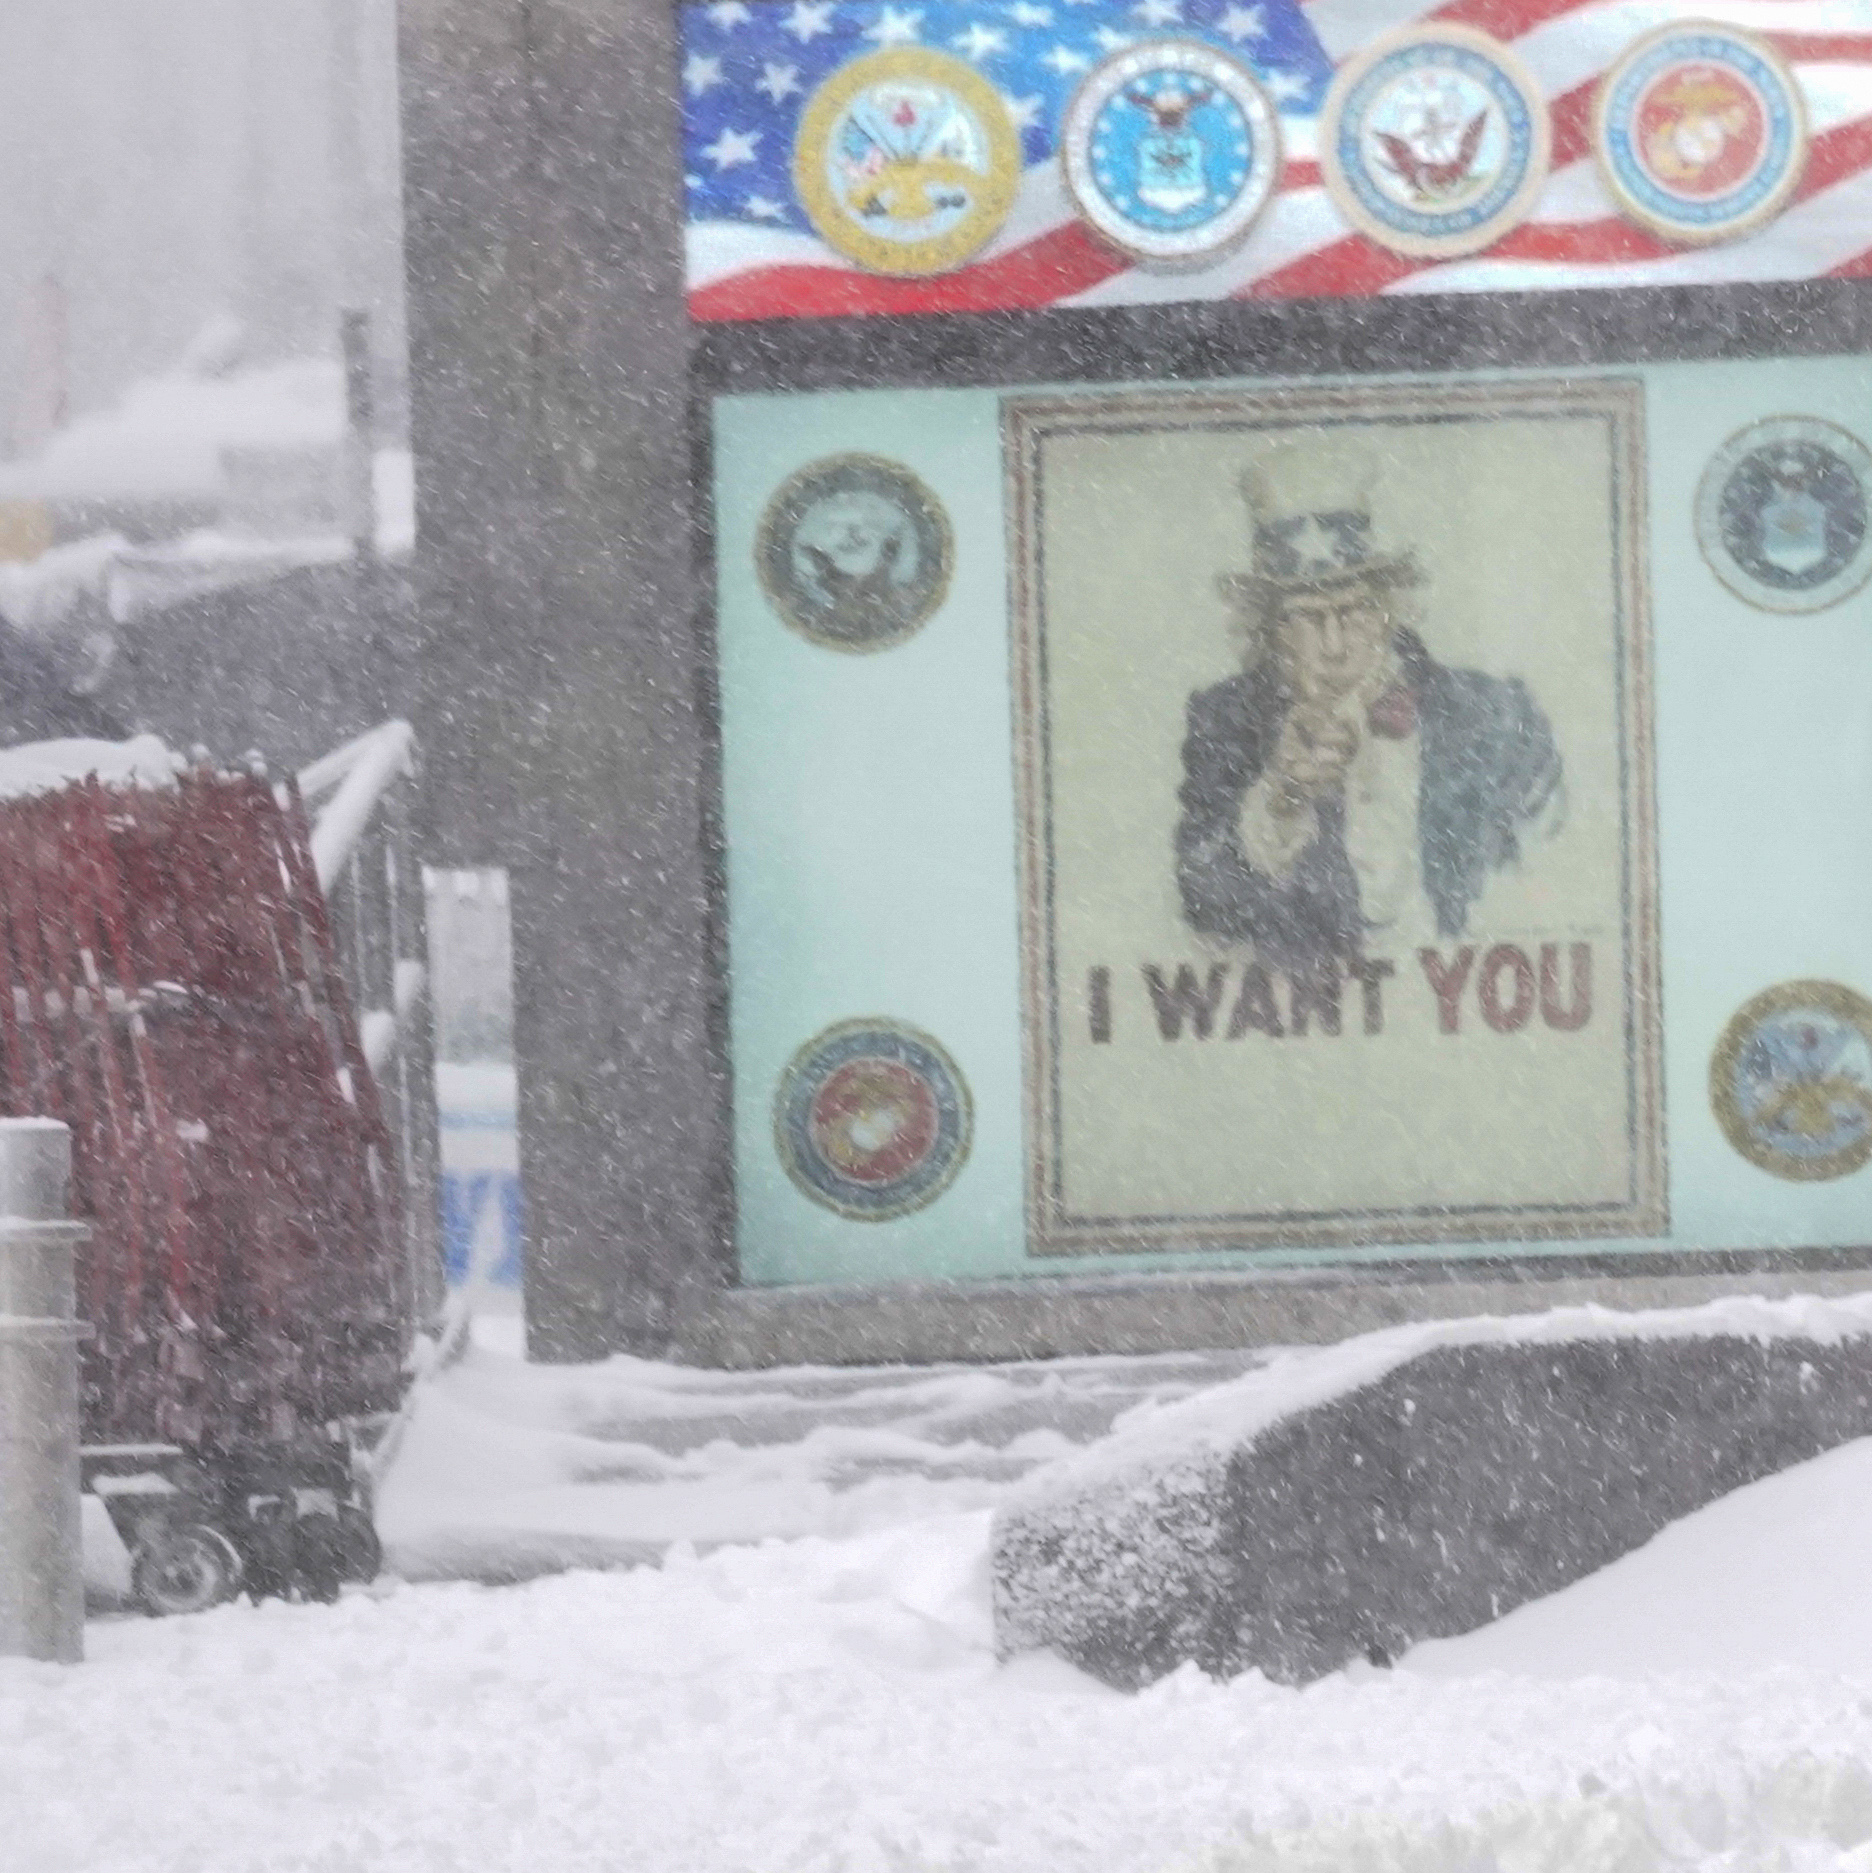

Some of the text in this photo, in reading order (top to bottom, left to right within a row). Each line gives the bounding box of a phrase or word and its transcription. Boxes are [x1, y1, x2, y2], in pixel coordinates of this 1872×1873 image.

[1088, 941, 1594, 1045] I WANT YOU
